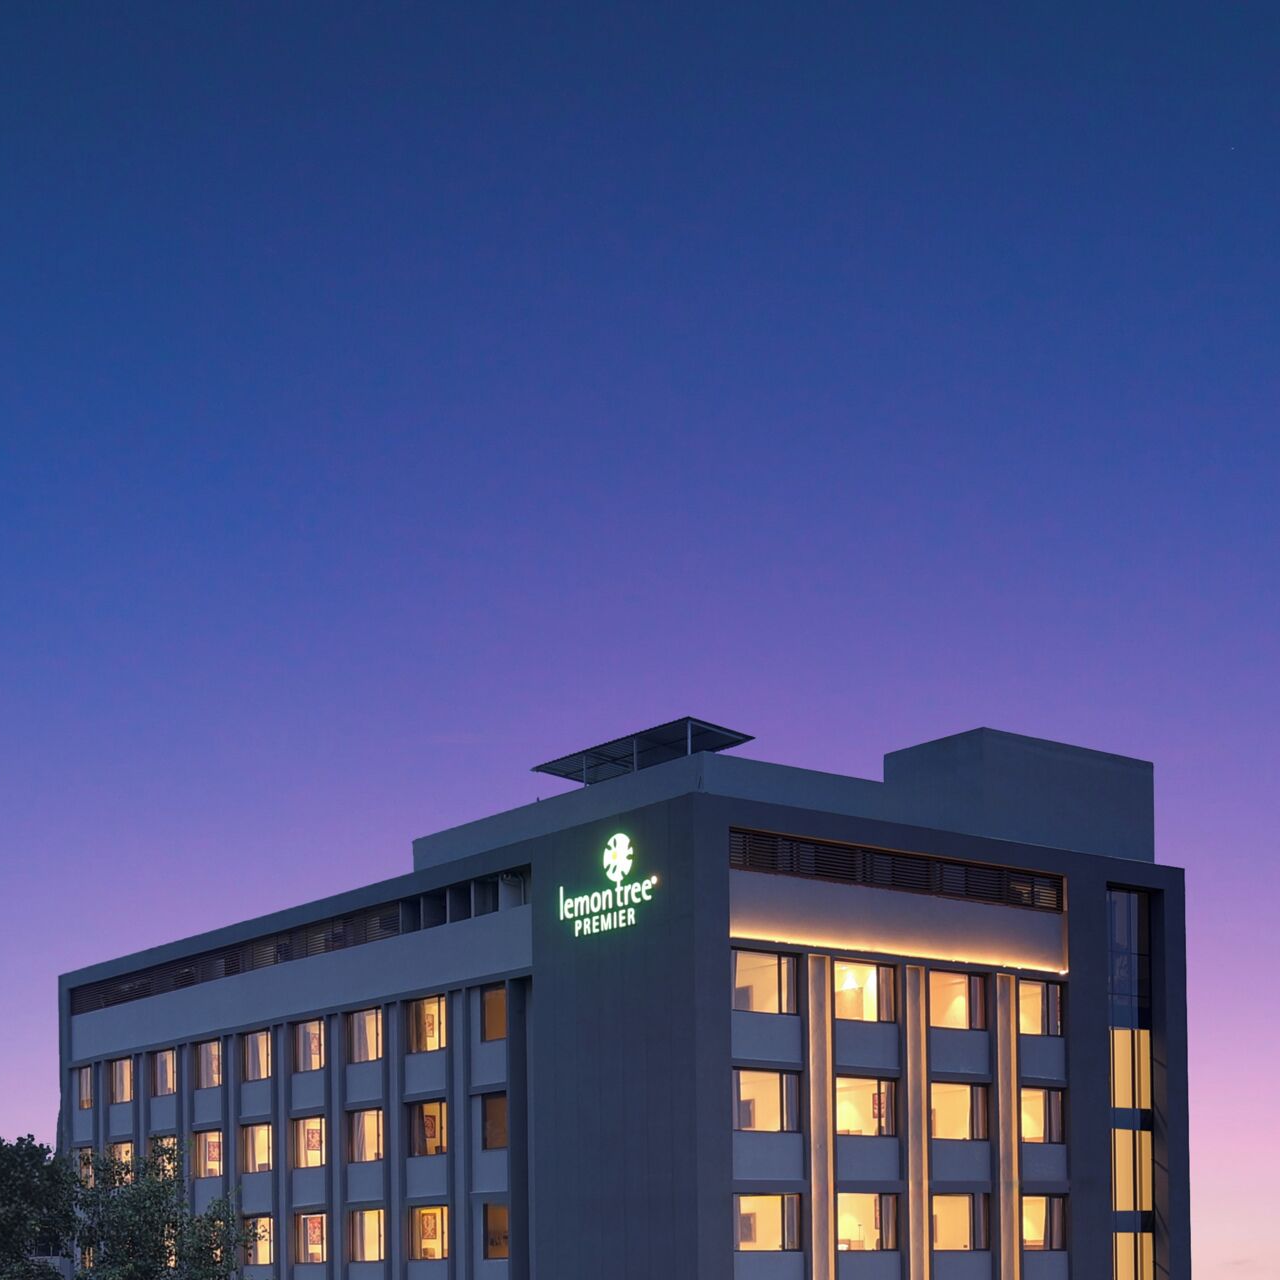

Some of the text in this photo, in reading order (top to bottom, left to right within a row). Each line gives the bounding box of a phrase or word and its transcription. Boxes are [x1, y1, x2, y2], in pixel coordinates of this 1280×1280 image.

[559, 878, 653, 921] lemon tree
[574, 907, 635, 937] PREMIER
